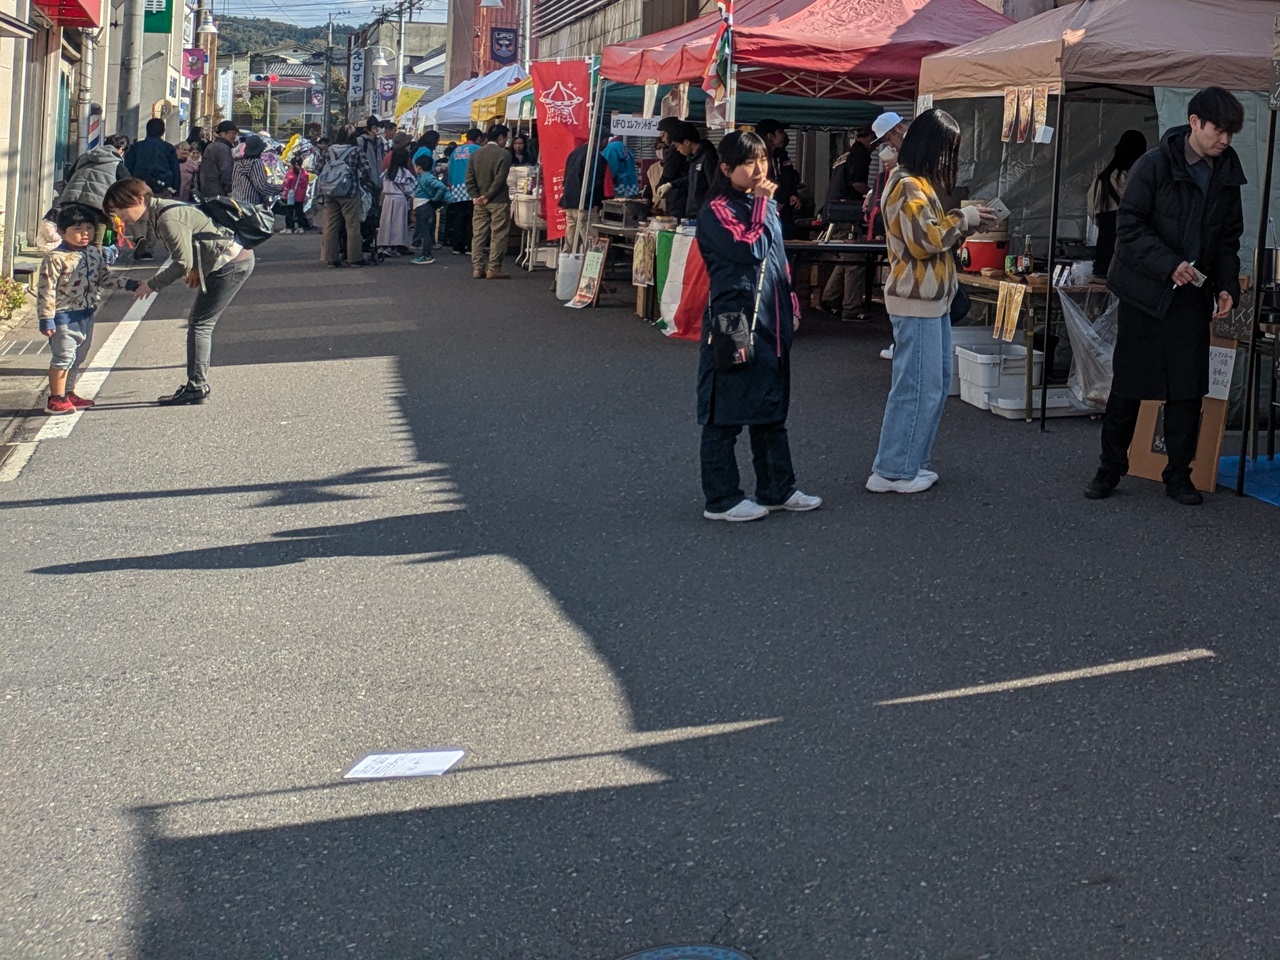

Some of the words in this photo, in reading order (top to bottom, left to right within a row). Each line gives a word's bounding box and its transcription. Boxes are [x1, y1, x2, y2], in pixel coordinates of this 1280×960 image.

[494, 32, 514, 40] UFO
[352, 49, 363, 95] えびすや
[612, 119, 626, 129] UFO
